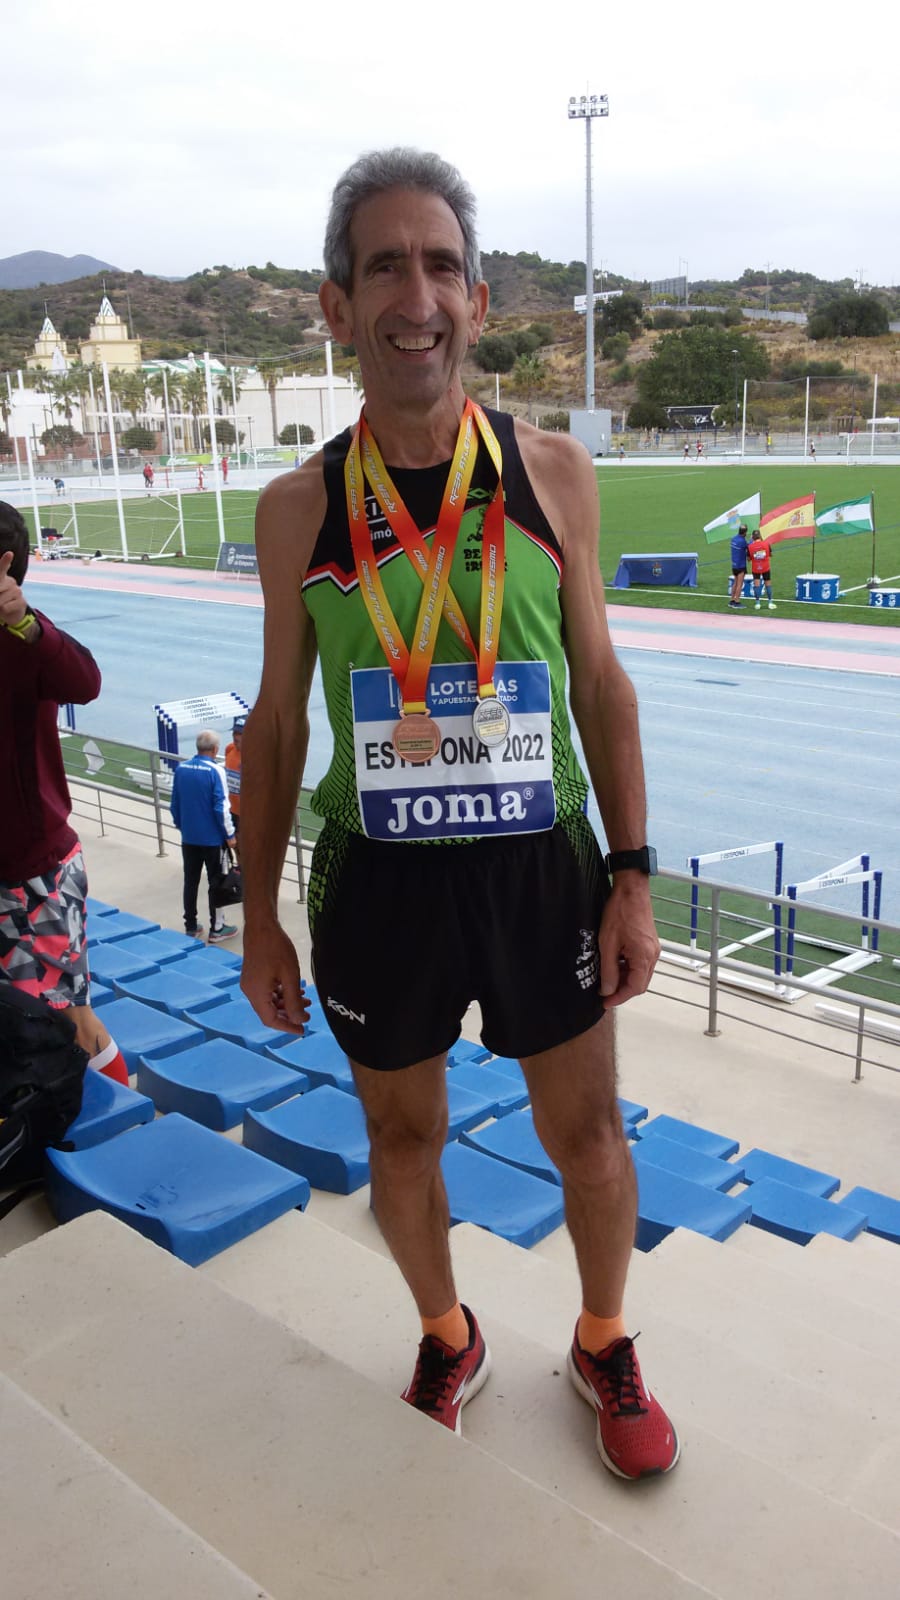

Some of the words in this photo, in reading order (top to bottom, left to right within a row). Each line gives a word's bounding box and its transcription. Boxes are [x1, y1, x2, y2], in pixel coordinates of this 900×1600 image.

[426, 545, 446, 616] ATLETISMO
[487, 543, 497, 613] ATLETISMO
[803, 581, 812, 598] 1
[875, 593, 883, 606] 3
[430, 677, 518, 696] LOTEAS
[438, 696, 477, 705] APUESTAS
[365, 737, 492, 770] ESONA
[502, 733, 545, 762] 2022
